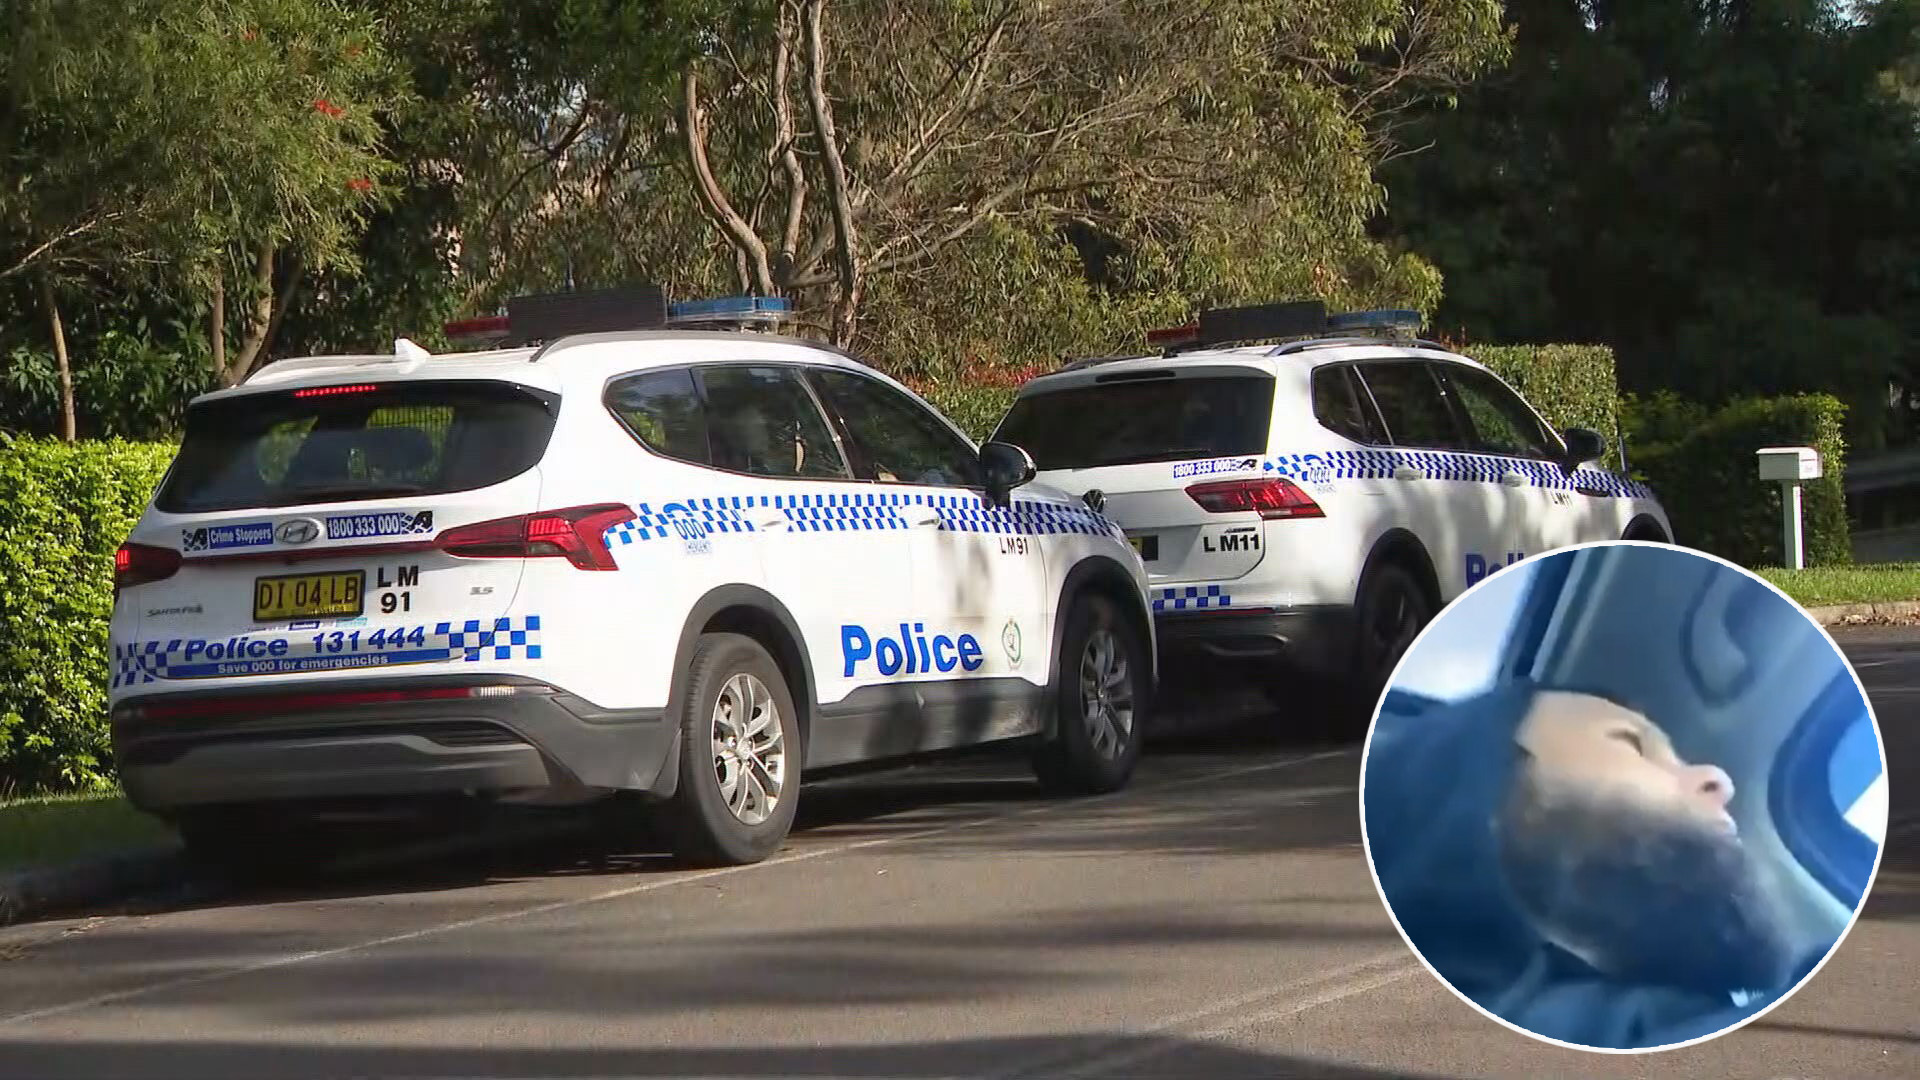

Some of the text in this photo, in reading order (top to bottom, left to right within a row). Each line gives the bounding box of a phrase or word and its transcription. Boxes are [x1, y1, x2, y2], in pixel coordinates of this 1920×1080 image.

[210, 527, 272, 546] Crime Stoppers
[328, 514, 400, 538] 1800 333 000
[999, 537, 1028, 555] LM91
[260, 576, 358, 609] DI 04 LB
[381, 591, 410, 613] 91
[185, 626, 425, 661] Police 131 444
[841, 622, 984, 677] Police
[218, 654, 389, 674] Save 000 for emergencies
